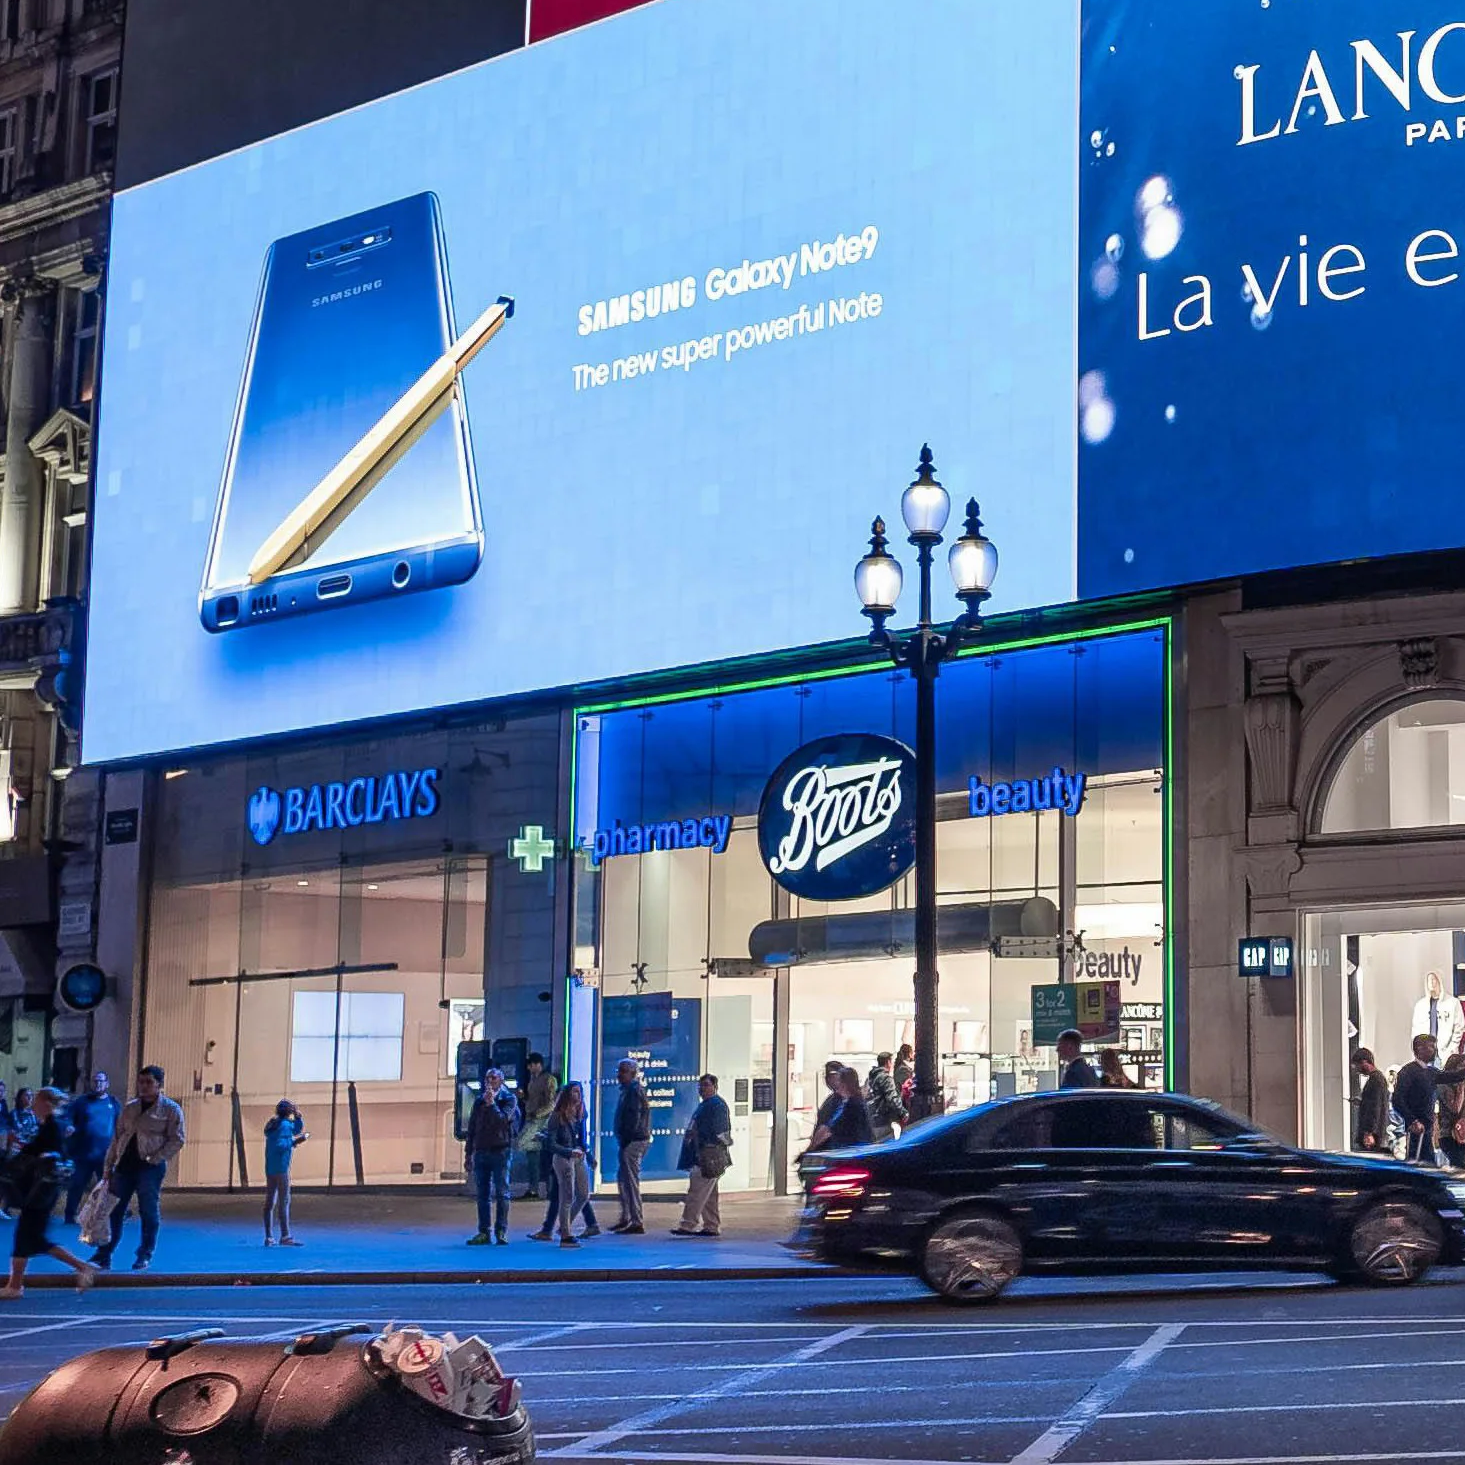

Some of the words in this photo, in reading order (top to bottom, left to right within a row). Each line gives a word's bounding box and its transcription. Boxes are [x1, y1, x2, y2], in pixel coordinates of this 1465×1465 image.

[312, 279, 383, 309] SAMSUNG
[578, 276, 697, 336] SAMSUNG
[705, 251, 798, 301] Galaxy
[800, 225, 879, 276] Note9
[1138, 272, 1213, 341] La
[1240, 235, 1366, 314] vie
[572, 359, 609, 392] The
[611, 349, 658, 381] new
[661, 333, 722, 371] super
[725, 301, 825, 362] powerful
[828, 291, 884, 328] Note
[284, 768, 438, 835] BARCLAYS
[769, 756, 902, 875] Boots
[967, 765, 1086, 817] beauty
[594, 812, 734, 866] pharmacy
[1243, 947, 1266, 967] GAP
[1036, 991, 1045, 1008] 3
[1057, 990, 1066, 1007] 2
